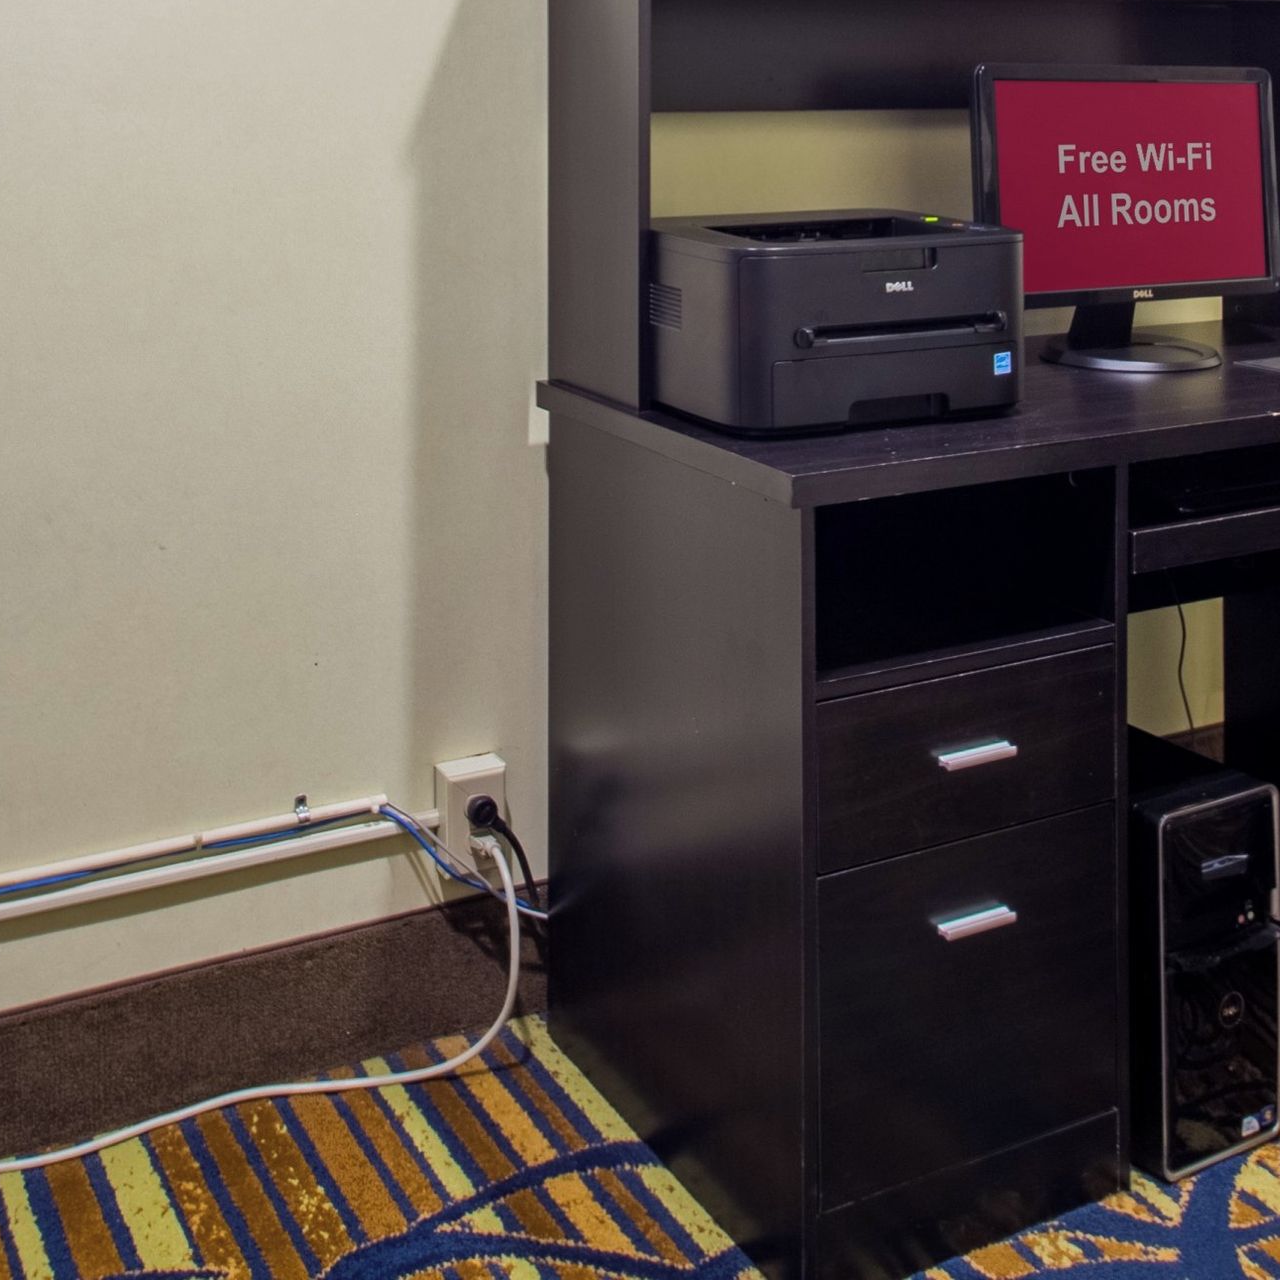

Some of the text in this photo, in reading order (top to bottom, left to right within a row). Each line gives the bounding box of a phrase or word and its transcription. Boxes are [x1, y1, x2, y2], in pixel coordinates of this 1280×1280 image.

[1058, 142, 1213, 174] Free Wi-Fi
[1057, 192, 1217, 228] All Rooms
[885, 281, 914, 293] DELL
[1133, 289, 1154, 299] DELL
